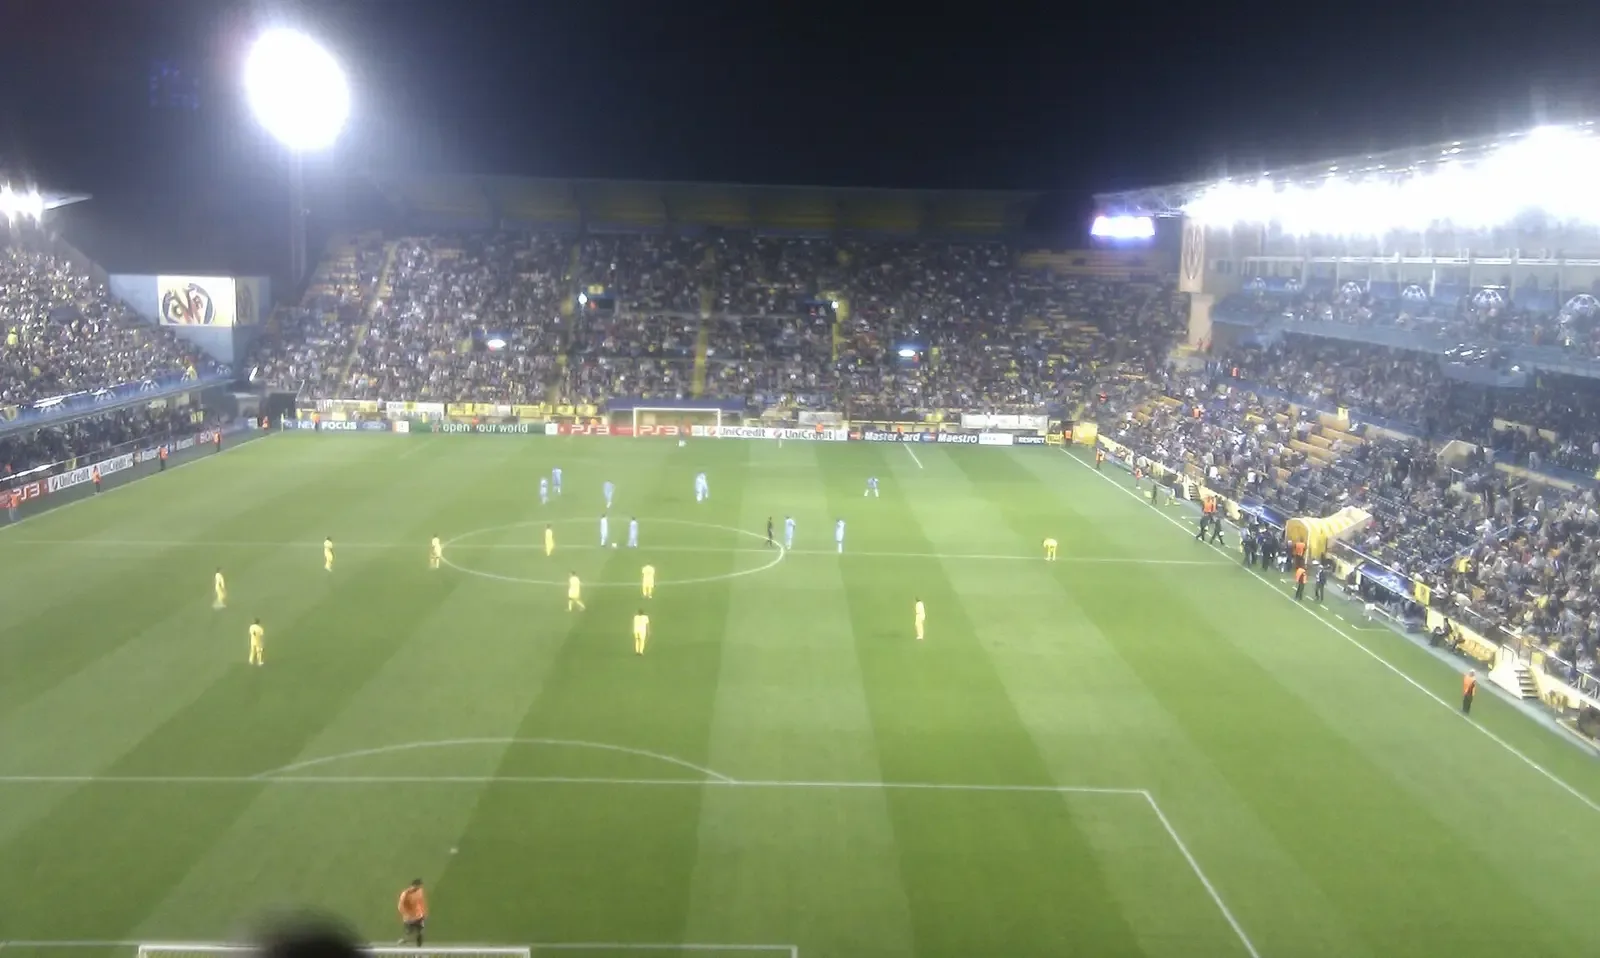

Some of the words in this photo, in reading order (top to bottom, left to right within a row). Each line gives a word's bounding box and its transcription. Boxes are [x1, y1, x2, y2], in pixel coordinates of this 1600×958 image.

[321, 420, 358, 431] FOCUS
[443, 423, 470, 433] open
[475, 423, 496, 434] our
[499, 423, 528, 433] world
[571, 424, 610, 435] PS3
[639, 424, 680, 435] PS3
[720, 427, 766, 438] UniCredit
[864, 431, 920, 442] Masterard
[937, 432, 977, 444] Maestro
[1018, 436, 1045, 444] RESPECT
[59, 465, 90, 488] UniCredit
[11, 482, 40, 501] PS3
